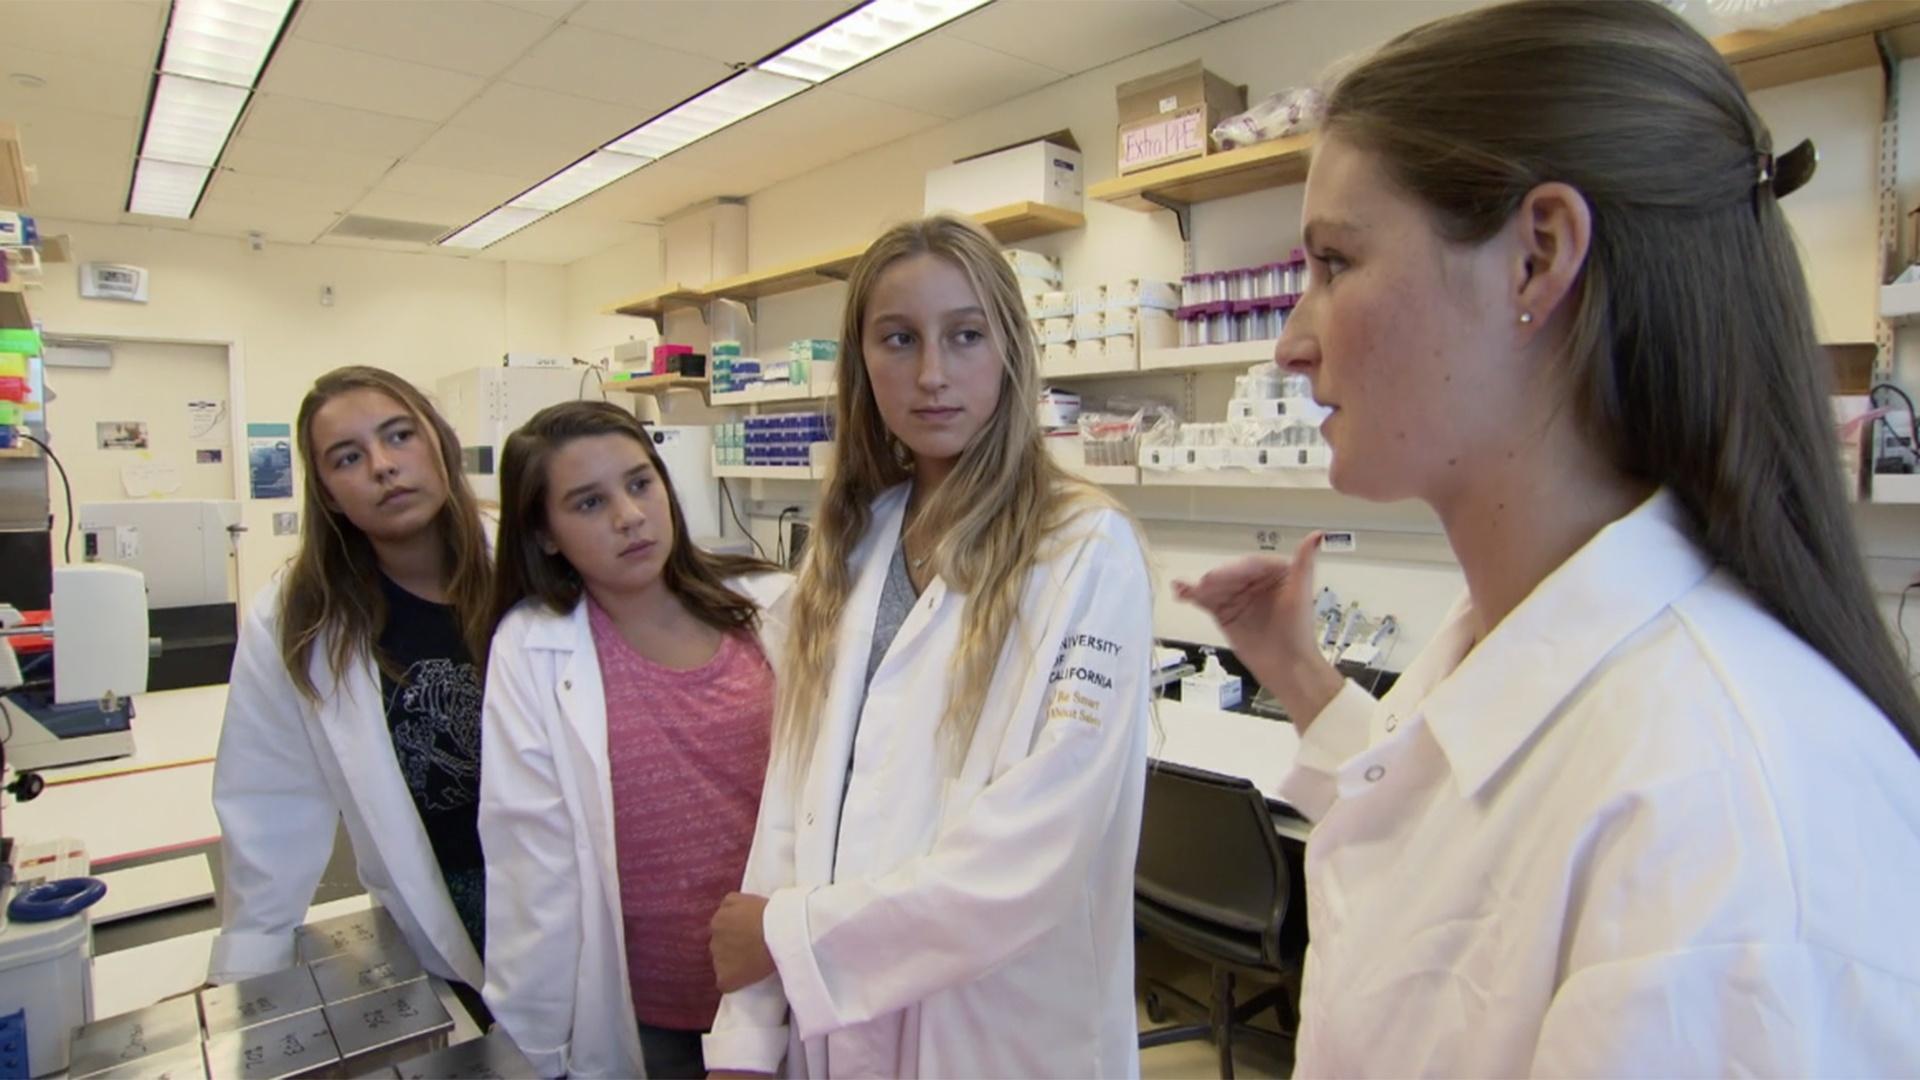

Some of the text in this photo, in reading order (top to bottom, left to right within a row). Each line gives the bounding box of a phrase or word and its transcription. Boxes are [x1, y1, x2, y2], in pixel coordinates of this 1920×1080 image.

[1126, 116, 1198, 162] Extra PPE
[1060, 634, 1122, 656] NIVERSITY
[1048, 667, 1112, 689] CALIFORNIA
